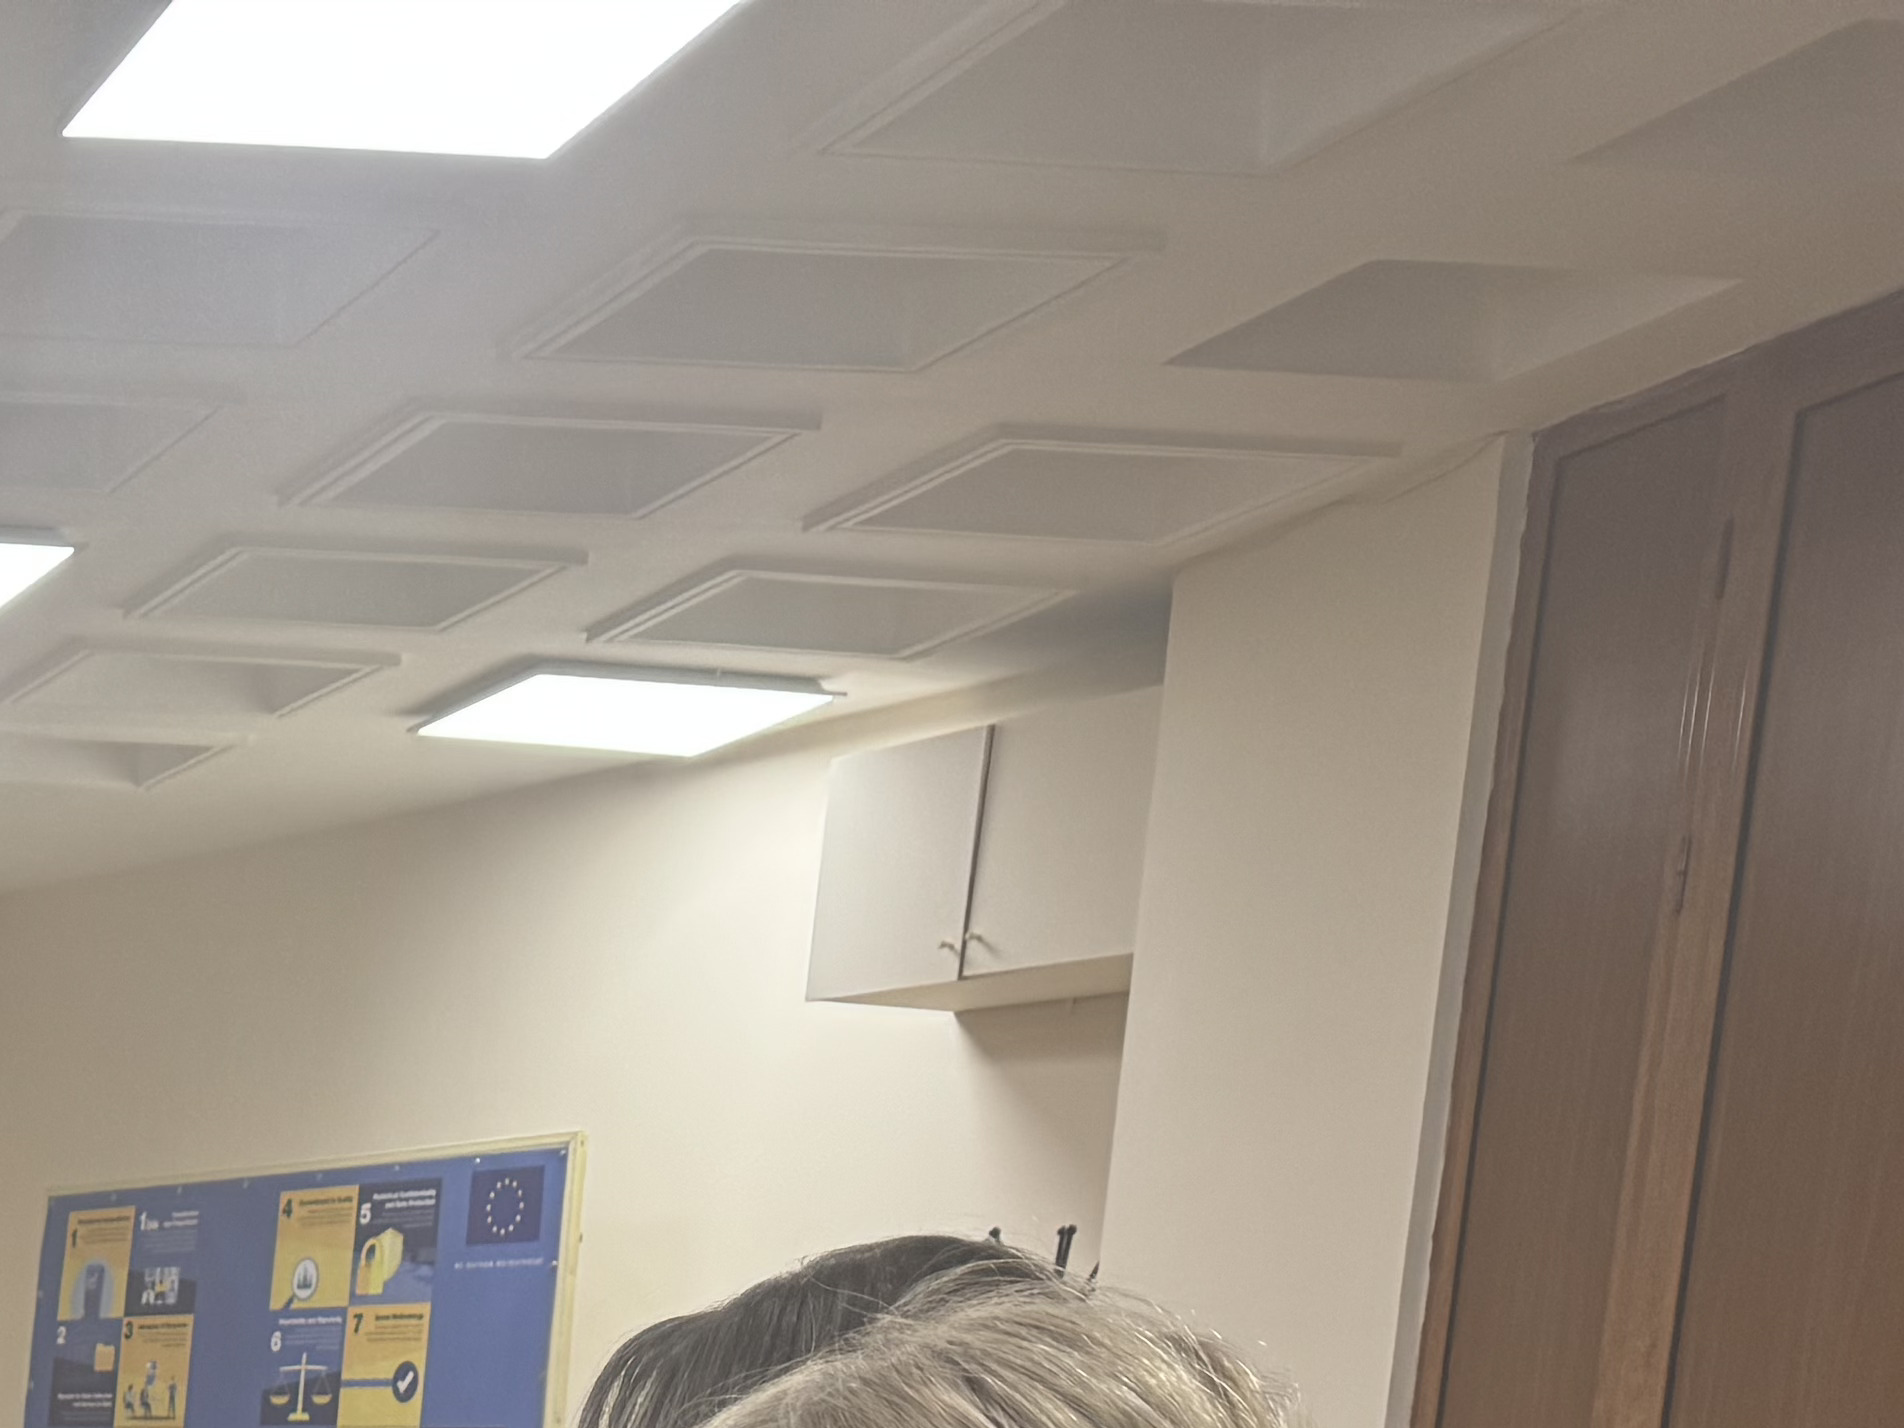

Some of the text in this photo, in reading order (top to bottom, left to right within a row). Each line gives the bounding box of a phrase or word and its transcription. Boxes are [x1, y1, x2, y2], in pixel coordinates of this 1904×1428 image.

[282, 1199, 294, 1219] 4
[360, 1203, 372, 1225] 5
[124, 1322, 134, 1340] 3
[353, 1313, 364, 1334] 7
[56, 1327, 67, 1344] 2
[271, 1331, 282, 1352] 6
